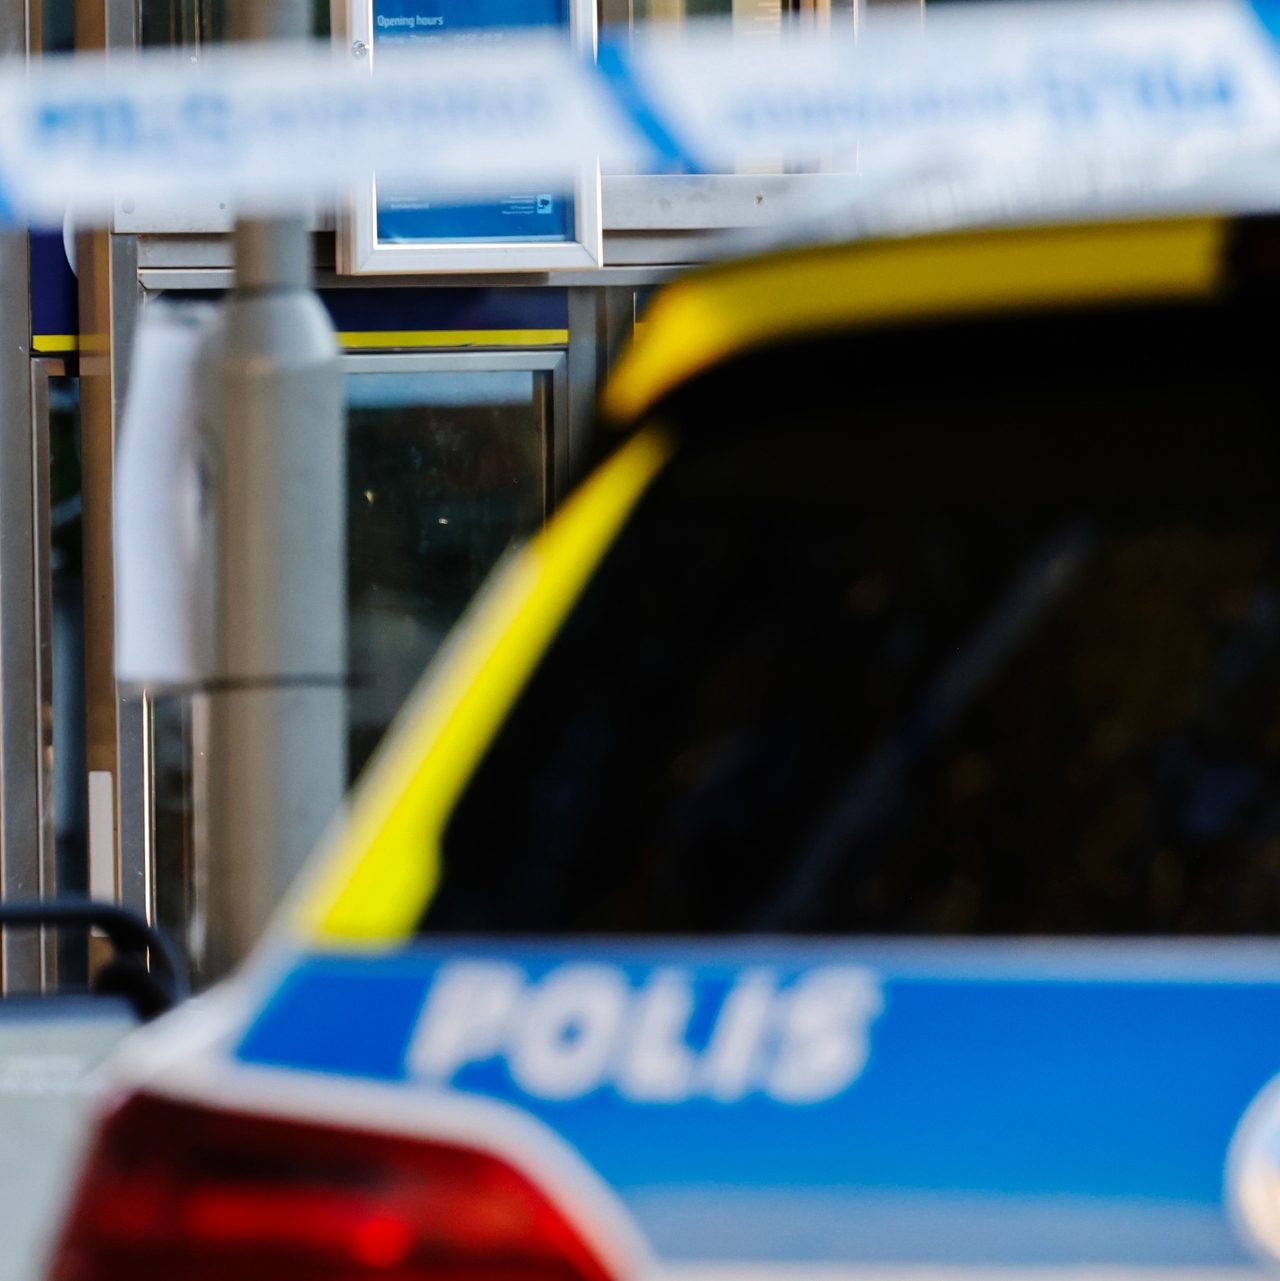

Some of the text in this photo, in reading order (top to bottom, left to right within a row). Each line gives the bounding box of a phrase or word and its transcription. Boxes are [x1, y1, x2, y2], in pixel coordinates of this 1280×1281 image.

[377, 15, 444, 28] Opening hours
[403, 958, 887, 1105] POLIS
